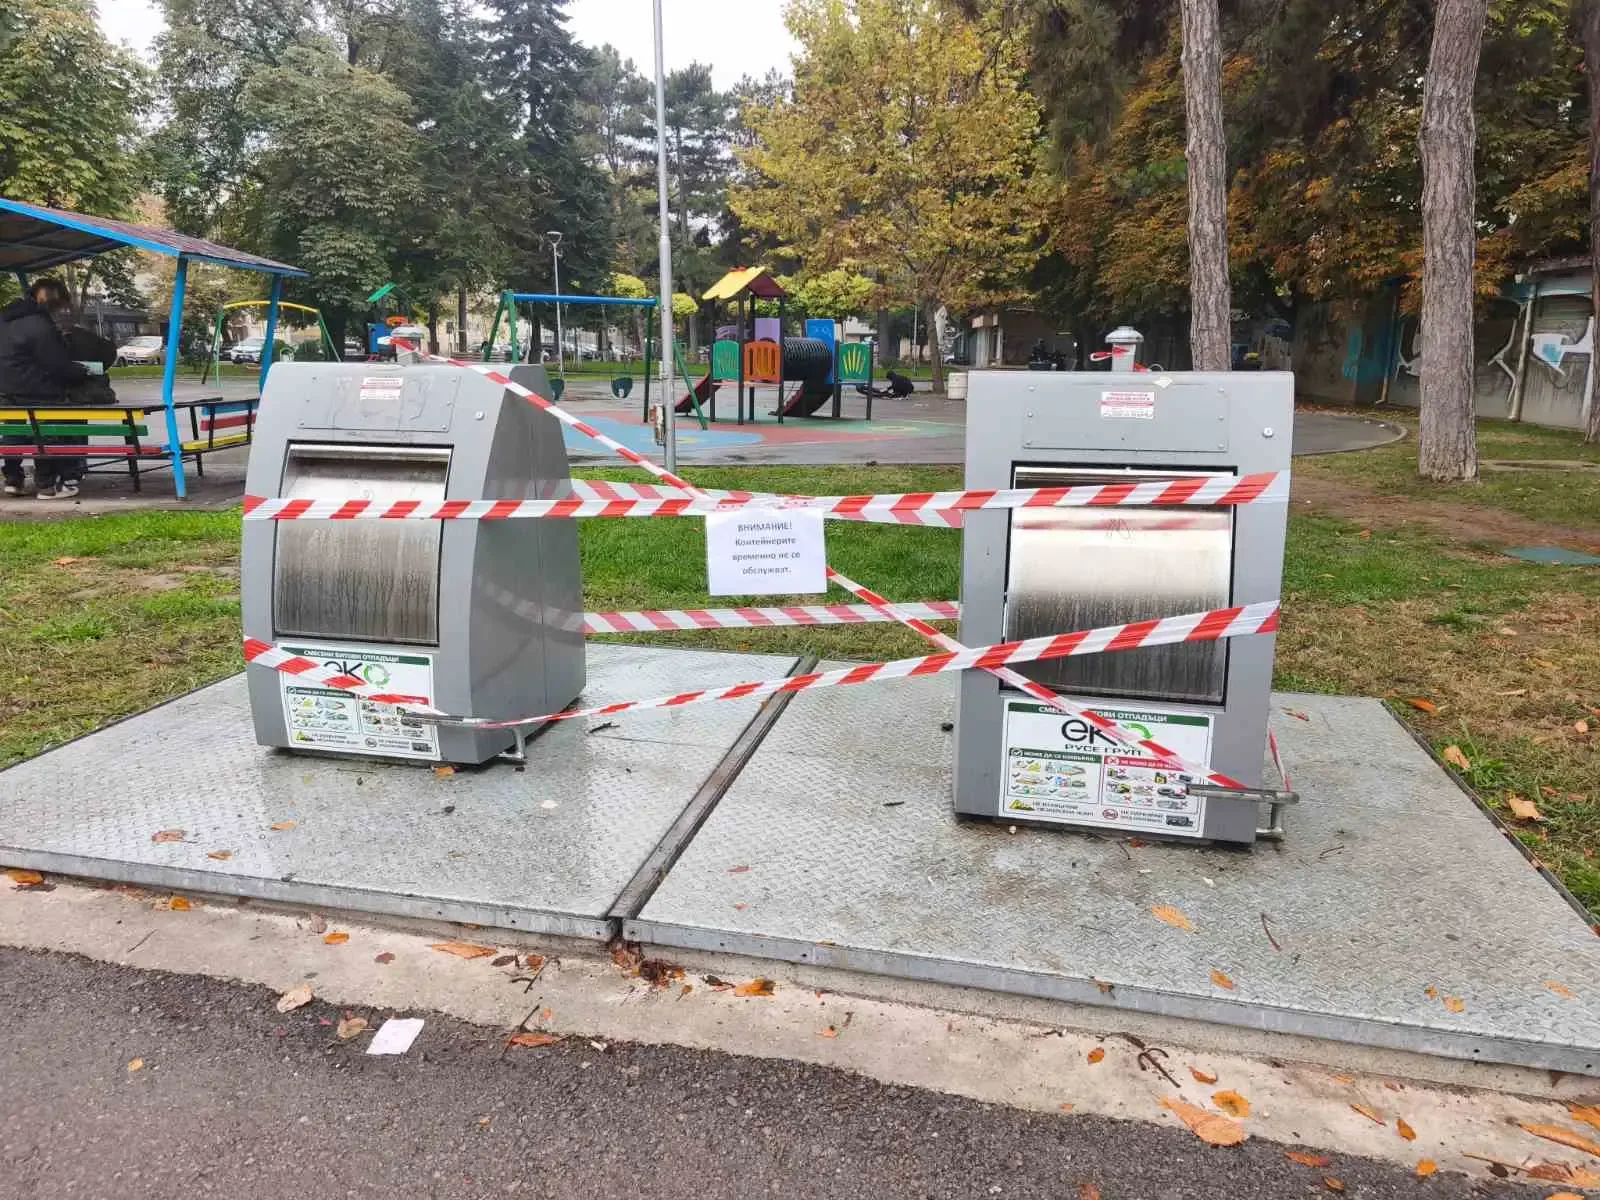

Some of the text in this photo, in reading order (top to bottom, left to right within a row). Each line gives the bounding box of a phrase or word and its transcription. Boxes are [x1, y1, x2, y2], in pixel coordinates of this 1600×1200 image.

[738, 520, 792, 532] ВНИМАНИЕ!
[735, 537, 797, 548] Контейнерите
[732, 553, 777, 563] временно
